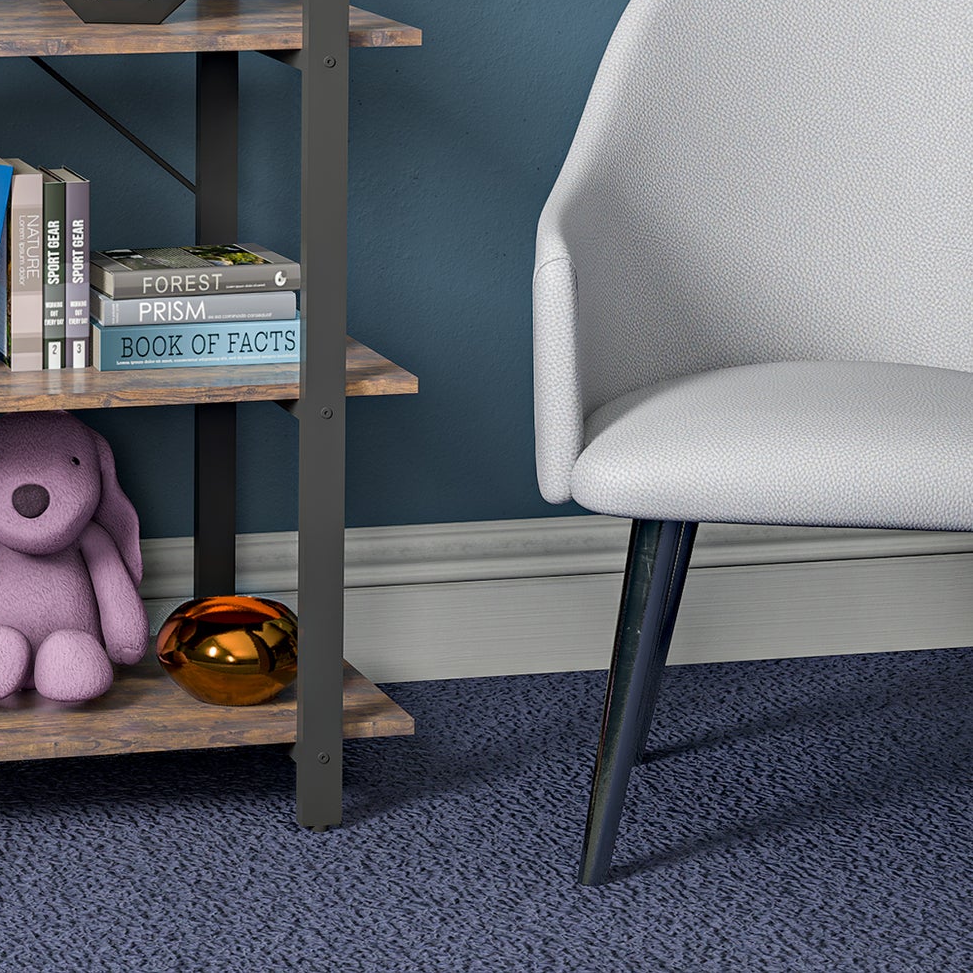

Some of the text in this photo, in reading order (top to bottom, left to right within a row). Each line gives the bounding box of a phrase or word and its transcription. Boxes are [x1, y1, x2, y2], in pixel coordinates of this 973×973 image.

[27, 214, 40, 279] NATURE
[48, 220, 60, 285] SPORT GEAR
[72, 219, 84, 284] SPORT GEAR
[142, 273, 223, 294] FOREST
[139, 300, 206, 322] PRISM
[52, 345, 58, 354] 2
[77, 344, 82, 353] 3
[121, 330, 296, 358] BOOK OF FACTS
